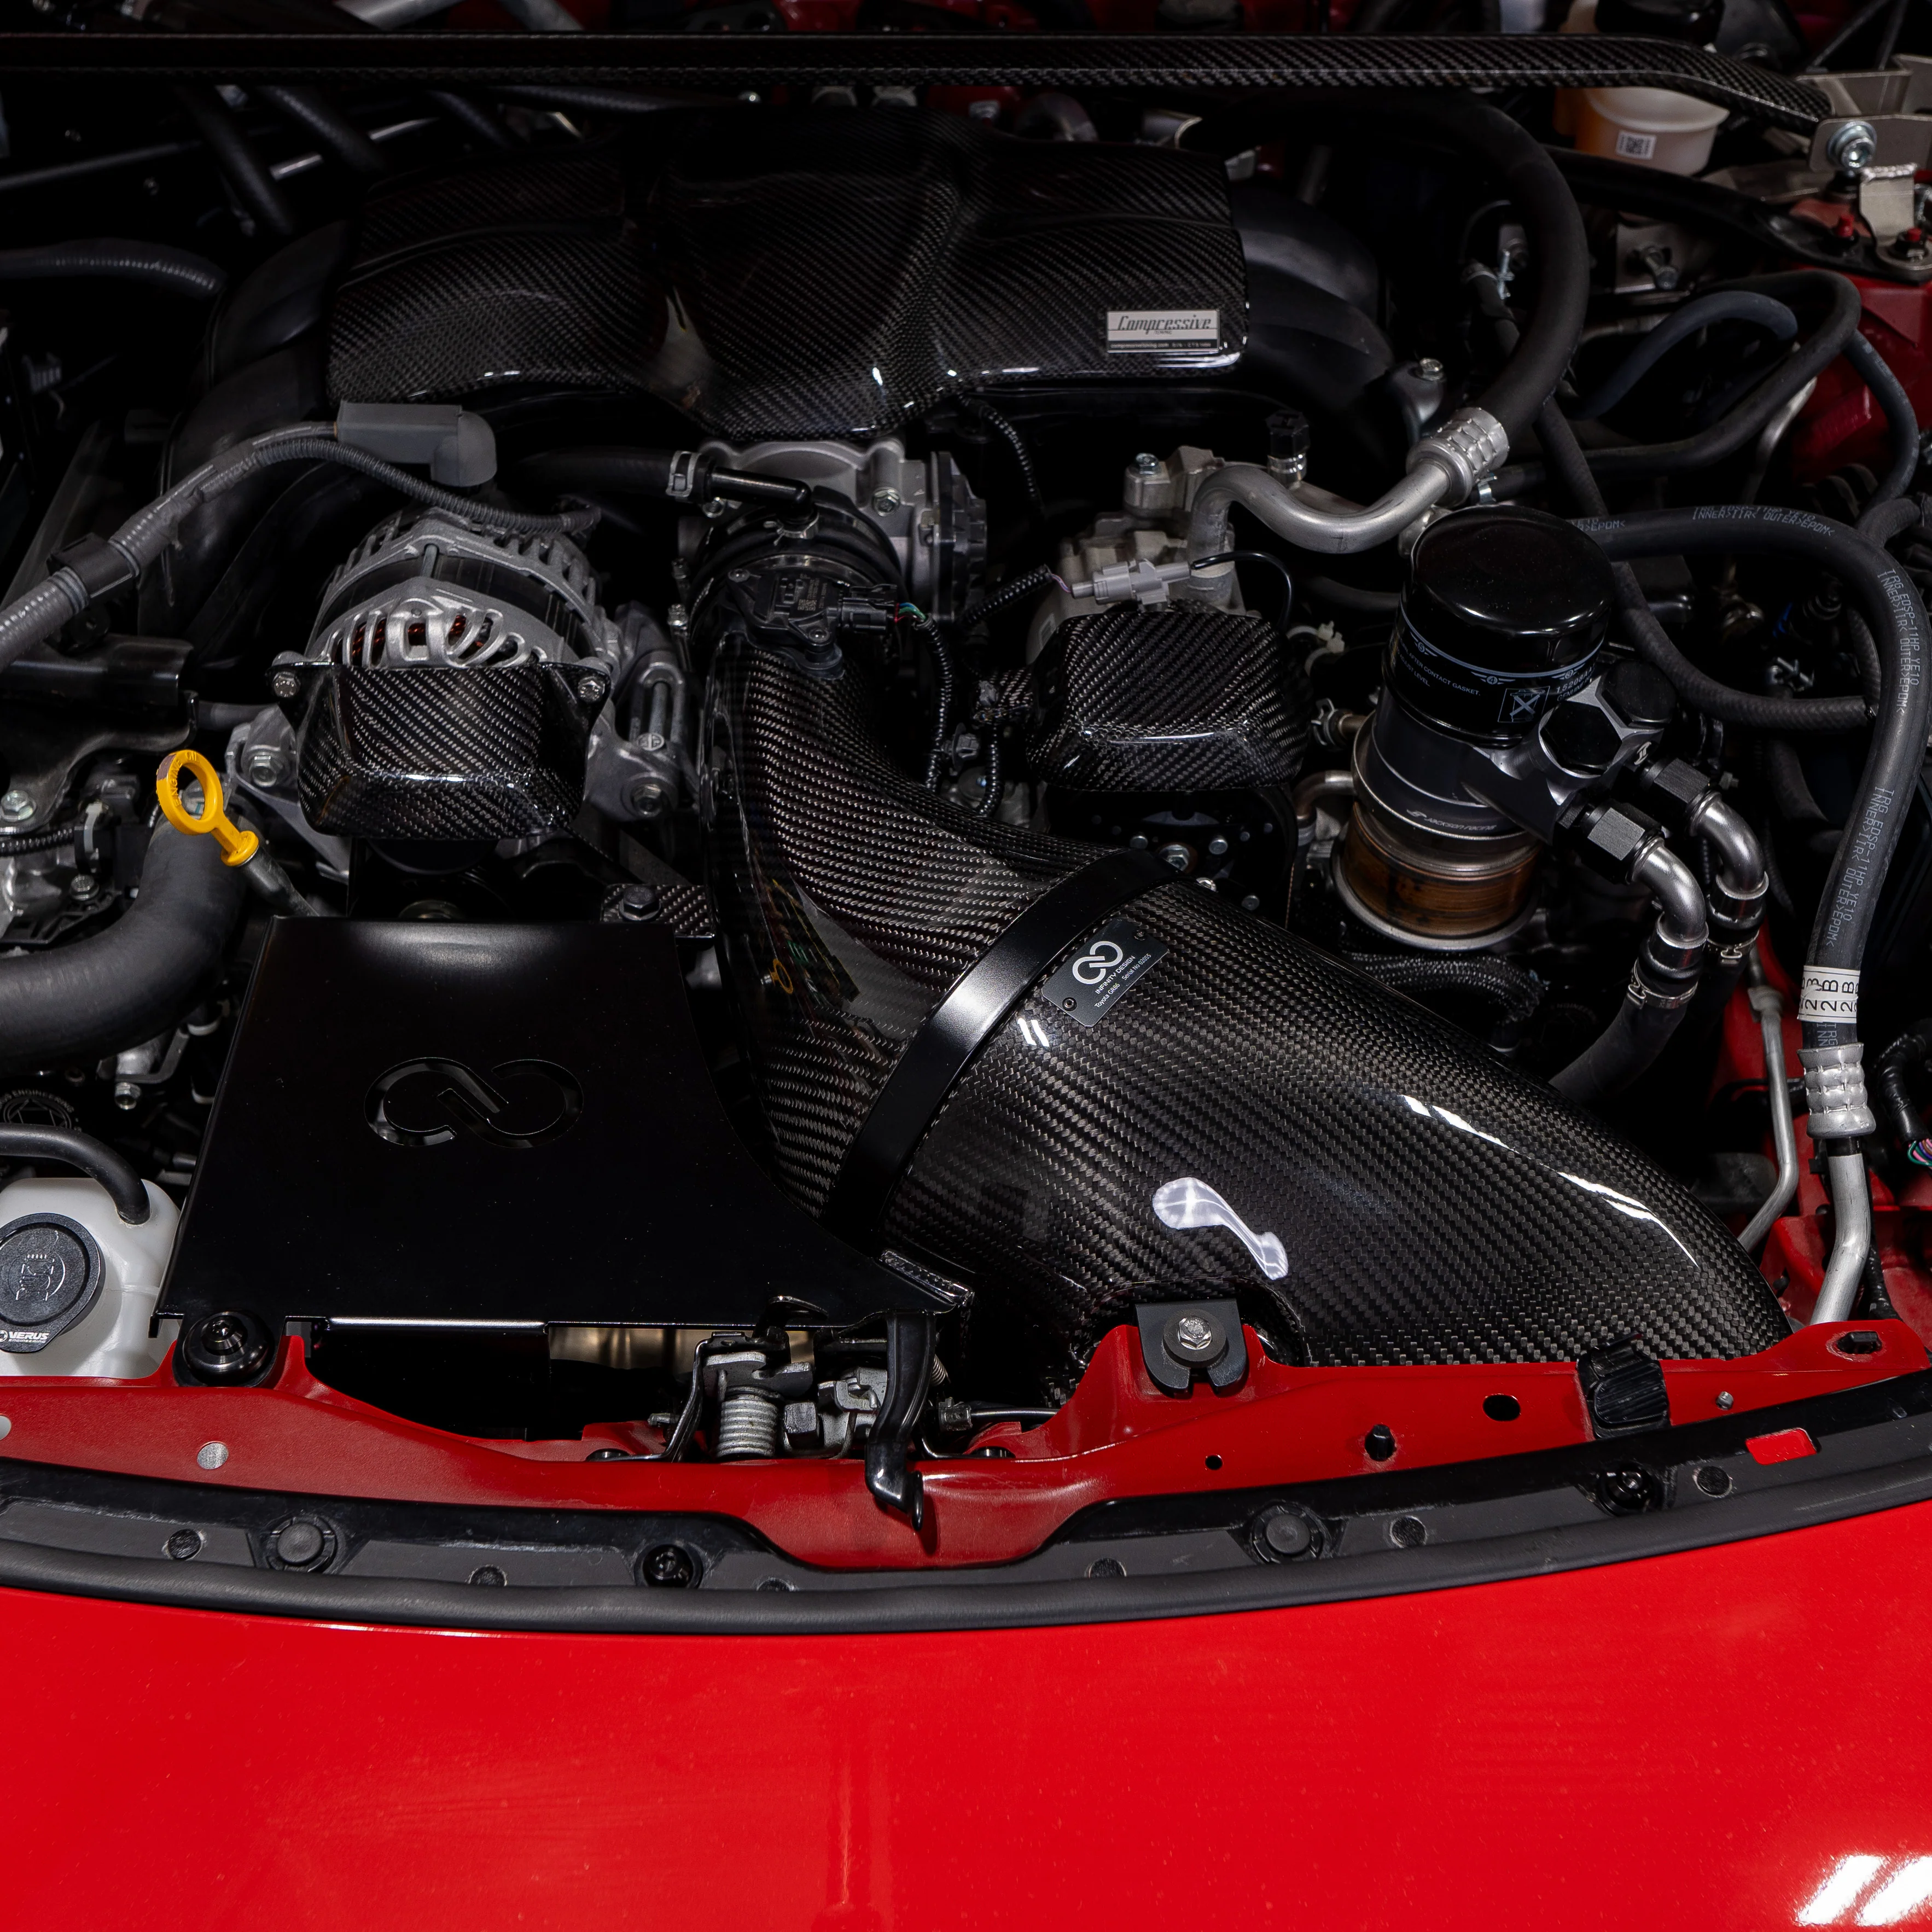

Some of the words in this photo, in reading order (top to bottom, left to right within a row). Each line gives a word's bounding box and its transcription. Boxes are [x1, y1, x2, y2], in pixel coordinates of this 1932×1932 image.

[1118, 314, 1211, 335] Compressive
[1423, 666, 1452, 685] CONTACT
[1452, 682, 1481, 696] GASKET.
[170, 759, 183, 807] ENGINE
[1877, 789, 1895, 814] TRG
[1851, 786, 1885, 862] INNER>IIR<
[1855, 819, 1884, 887] EDSP-11HP
[1826, 866, 1857, 948] OUTER>EPDM<
[1842, 892, 1860, 922] YE10
[1094, 994, 1110, 1008] Toyota
[1108, 982, 1120, 994] GR86
[1121, 969, 1135, 981] Serial
[1138, 953, 1151, 965] 02055
[1095, 972, 1117, 994] INFINITY
[1115, 955, 1136, 974] DESIGN
[1816, 1023, 1829, 1047] INN
[8, 1331, 50, 1340] VERUS
